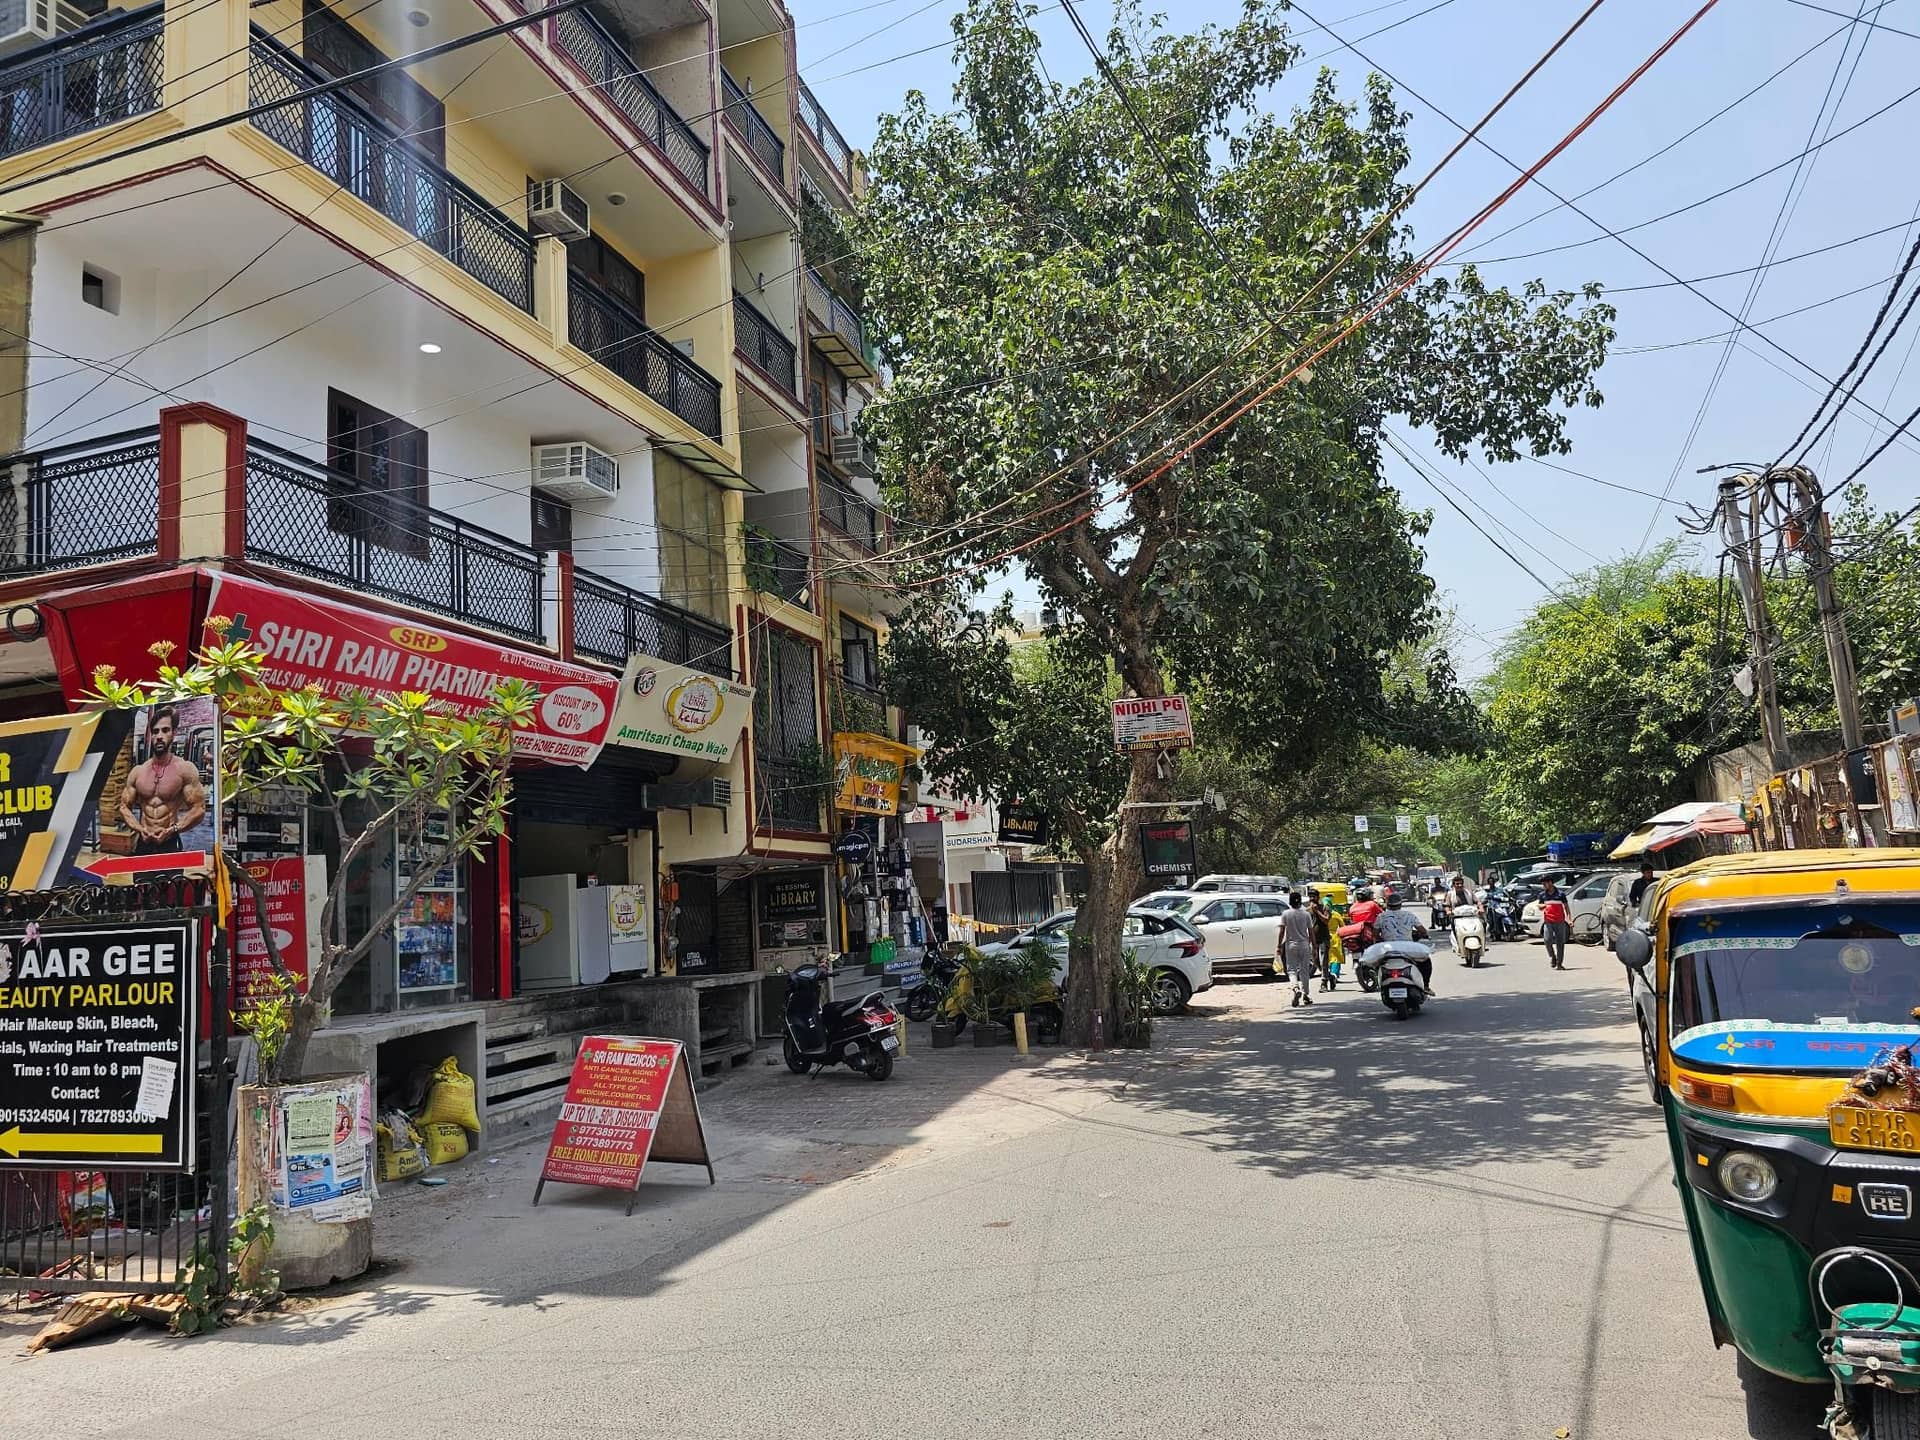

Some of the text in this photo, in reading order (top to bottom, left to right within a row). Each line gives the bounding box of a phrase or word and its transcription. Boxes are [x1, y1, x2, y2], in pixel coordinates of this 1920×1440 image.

[400, 629, 438, 651] SRP
[254, 621, 333, 669] SHRI
[335, 641, 400, 683] RAM
[291, 672, 306, 689] IN
[552, 694, 580, 710] DISCOUNT
[1115, 701, 1157, 716] NIDHI
[1161, 699, 1183, 711] PG
[557, 712, 582, 730] 60%
[535, 738, 555, 752] HOME
[617, 725, 728, 755] Amritsari Chaap Wale
[946, 836, 993, 846] SUDARSHAN
[1149, 863, 1192, 873] CHEMIST
[770, 890, 816, 906] LIBRARY
[19, 943, 176, 979] AAR GEE
[69, 981, 175, 1007] PARLOUR
[1, 1015, 159, 1033] Hair Makeup Skin, Bleach,
[29, 1041, 73, 1057] Waxing
[76, 1040, 103, 1053] Hair
[105, 1038, 179, 1053] Treatments
[593, 1050, 658, 1069] SRI RAM MEDICOS
[13, 1063, 44, 1077] Time
[54, 1063, 69, 1077] 10
[71, 1066, 90, 1077] am
[93, 1064, 107, 1077] to
[110, 1063, 118, 1076] 8
[122, 1065, 141, 1079] pm
[51, 1087, 100, 1100] Contact
[581, 1097, 619, 1106] AVAILABLE
[563, 1105, 575, 1120] UP
[576, 1106, 586, 1121] TO
[587, 1107, 596, 1122] 10
[598, 1108, 616, 1126] 50%
[616, 1110, 654, 1128] DISCOUNT
[578, 1125, 637, 1140] 9773897772
[575, 1136, 634, 1151] 9773897773
[551, 1145, 641, 1167] FREE HOME DELIVERY
[1870, 1195, 1905, 1213] RE
